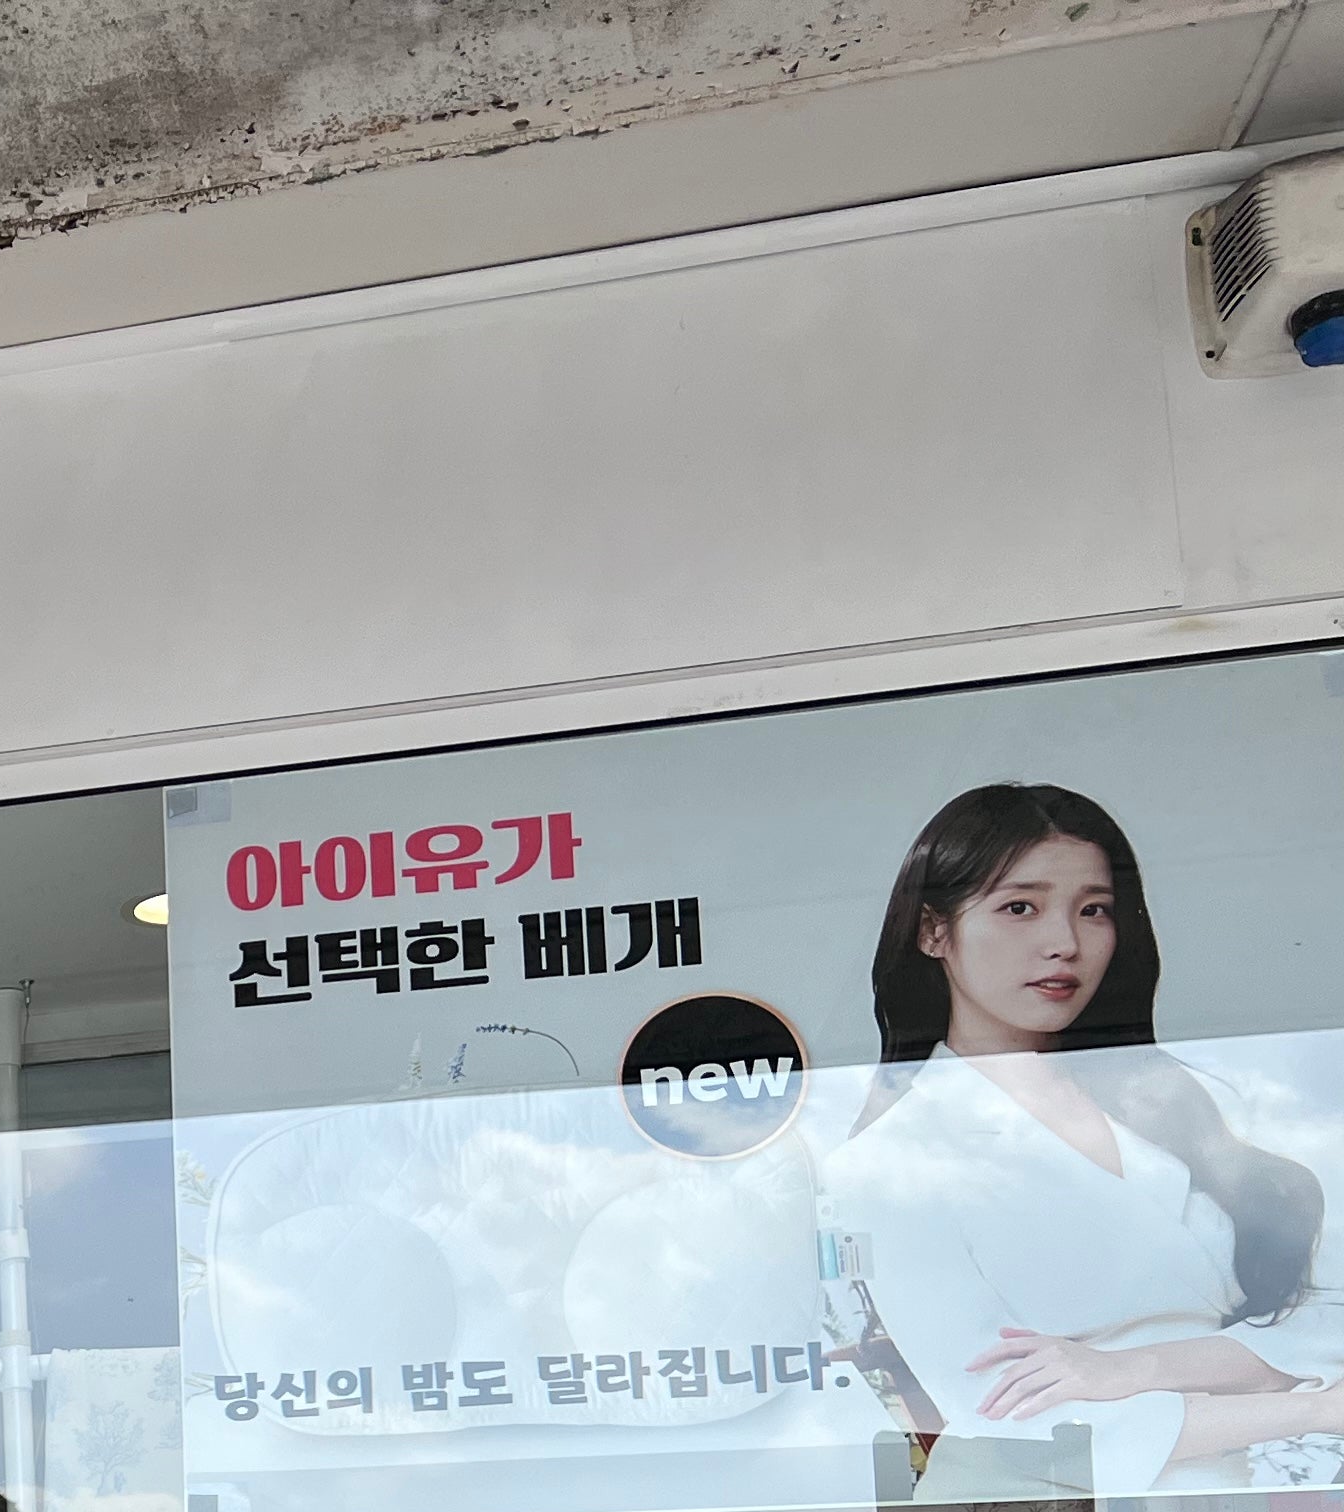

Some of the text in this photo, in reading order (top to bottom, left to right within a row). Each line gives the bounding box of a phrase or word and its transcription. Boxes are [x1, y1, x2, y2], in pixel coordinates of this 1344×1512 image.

[225, 811, 583, 913] 아이유가
[227, 897, 703, 1010] 선택한 베개
[638, 1056, 795, 1108] new
[214, 1340, 852, 1423] 당신의 밤도 달라집니다.
